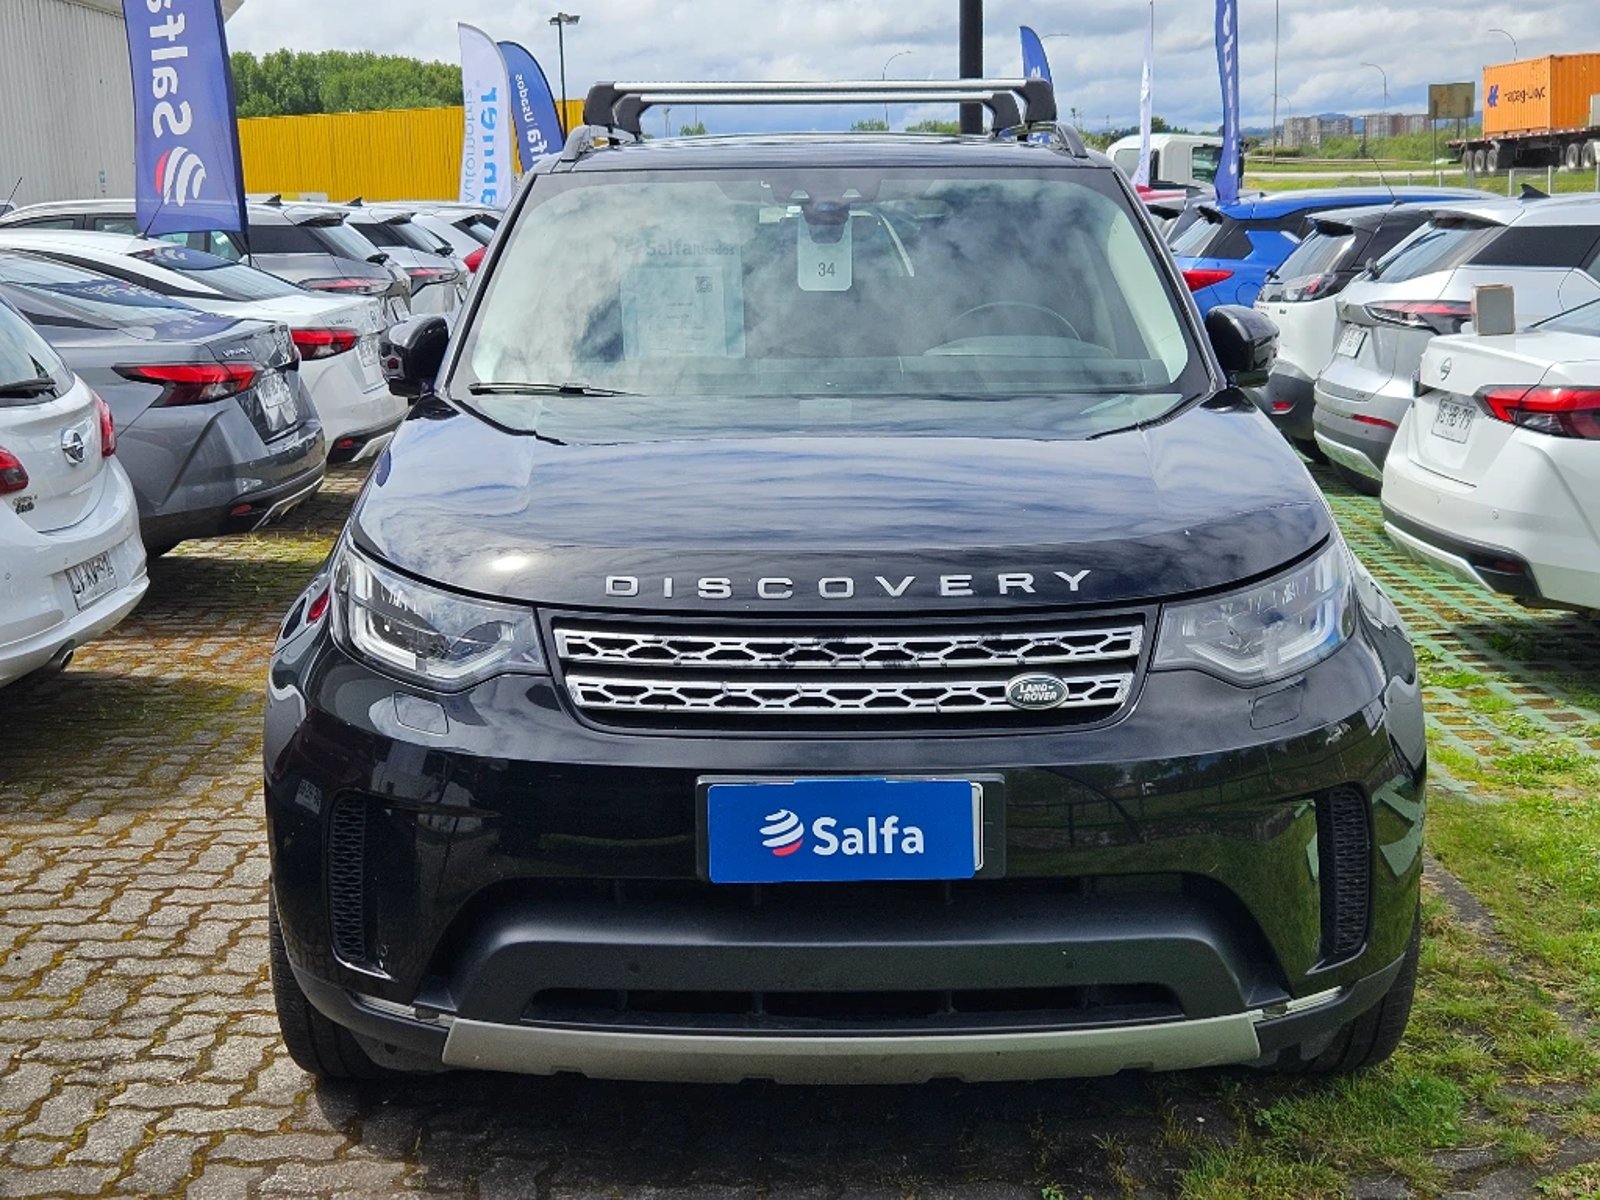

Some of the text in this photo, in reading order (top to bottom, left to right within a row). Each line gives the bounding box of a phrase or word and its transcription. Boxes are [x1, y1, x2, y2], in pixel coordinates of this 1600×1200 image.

[646, 239, 693, 257] Salfa
[818, 262, 836, 278] 34
[605, 569, 1092, 599] DISCOVERY
[812, 815, 925, 856] Salfa
